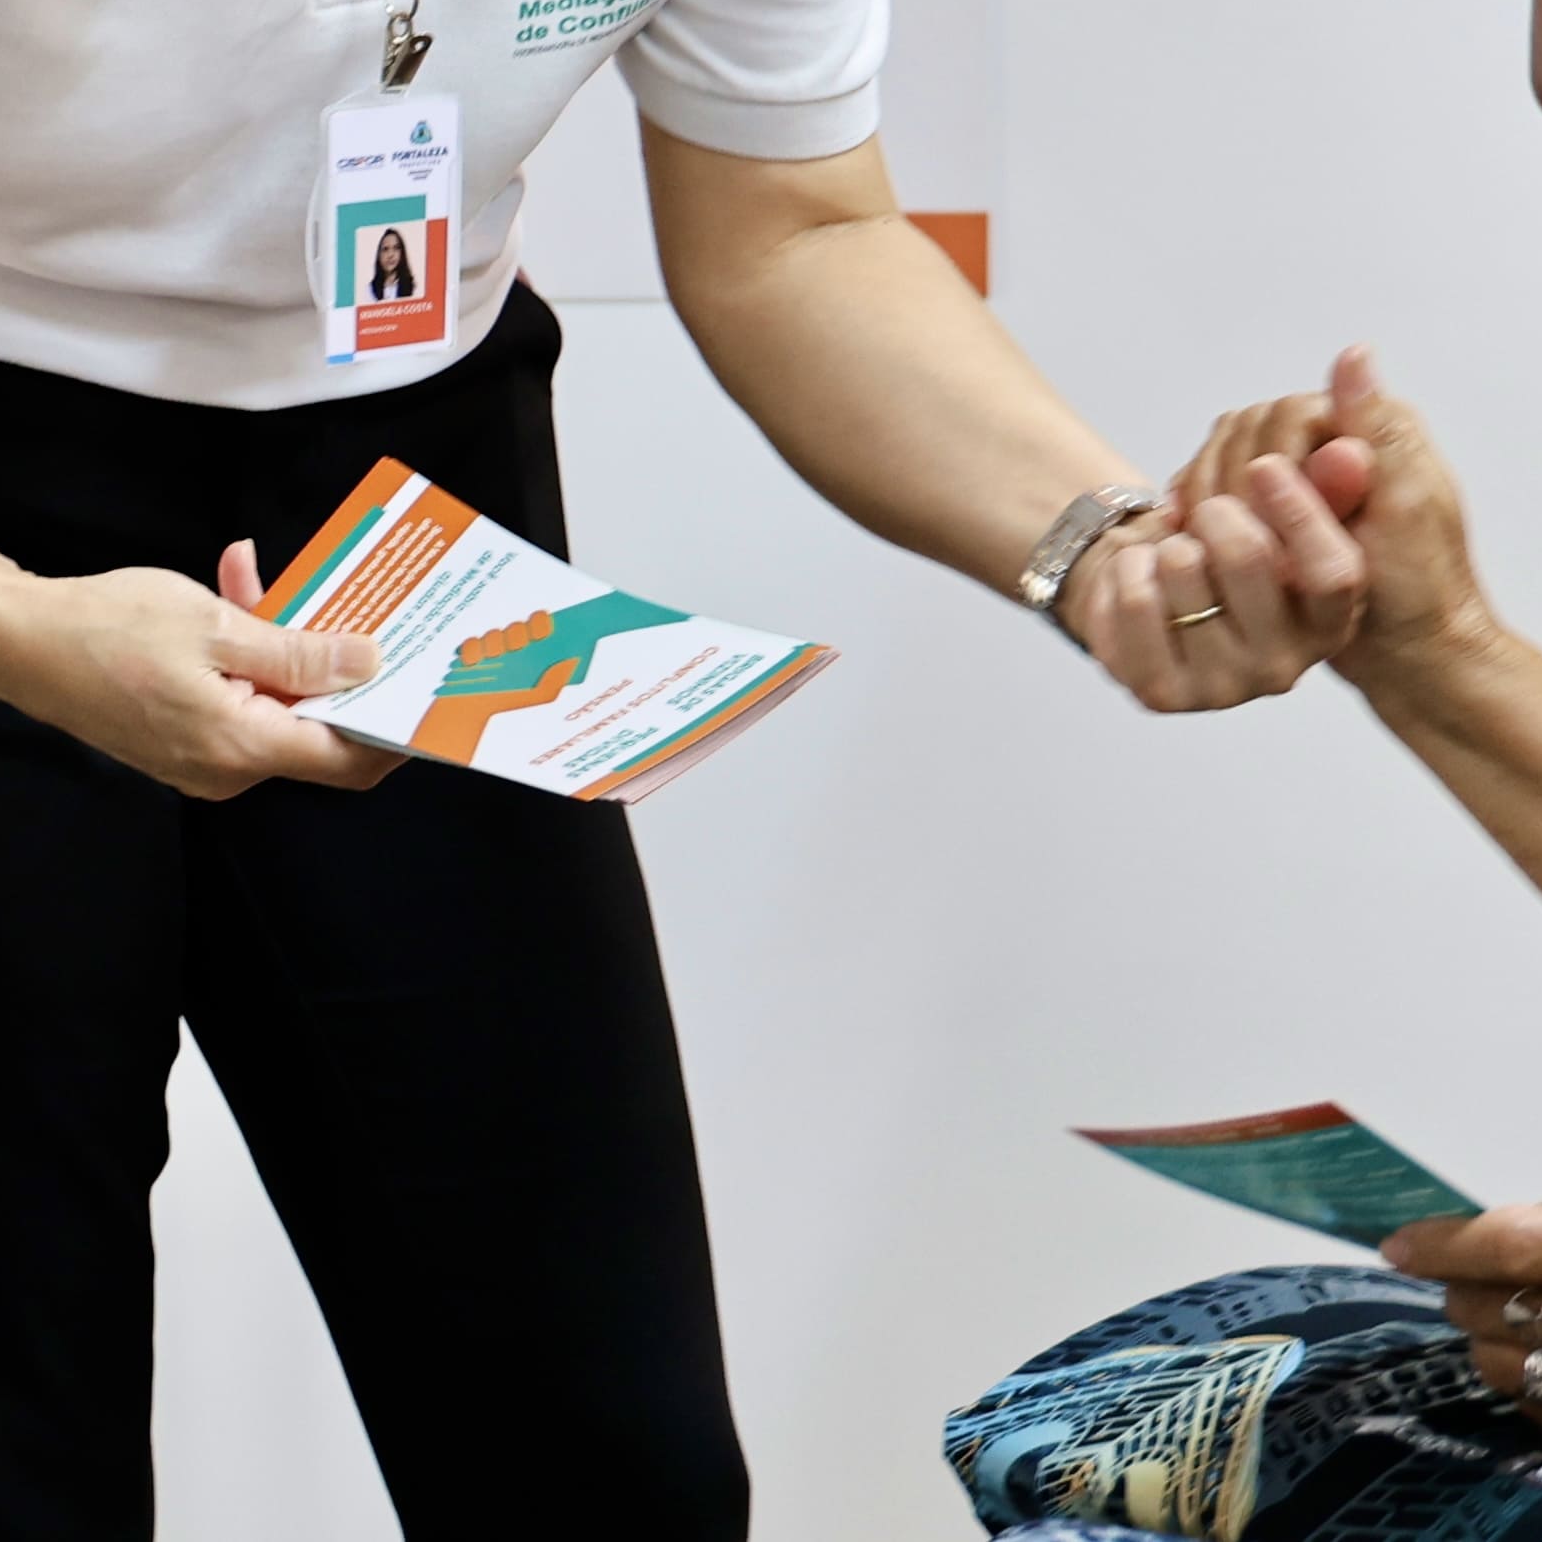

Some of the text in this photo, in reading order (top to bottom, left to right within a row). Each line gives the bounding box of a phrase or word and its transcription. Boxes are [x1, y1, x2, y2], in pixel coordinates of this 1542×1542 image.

[516, 25, 548, 43] de
[527, 645, 721, 767] CONFLITOS FAMILIARES
[666, 653, 744, 705] VIZINHOS
[674, 655, 766, 713] BRIGAS DE
